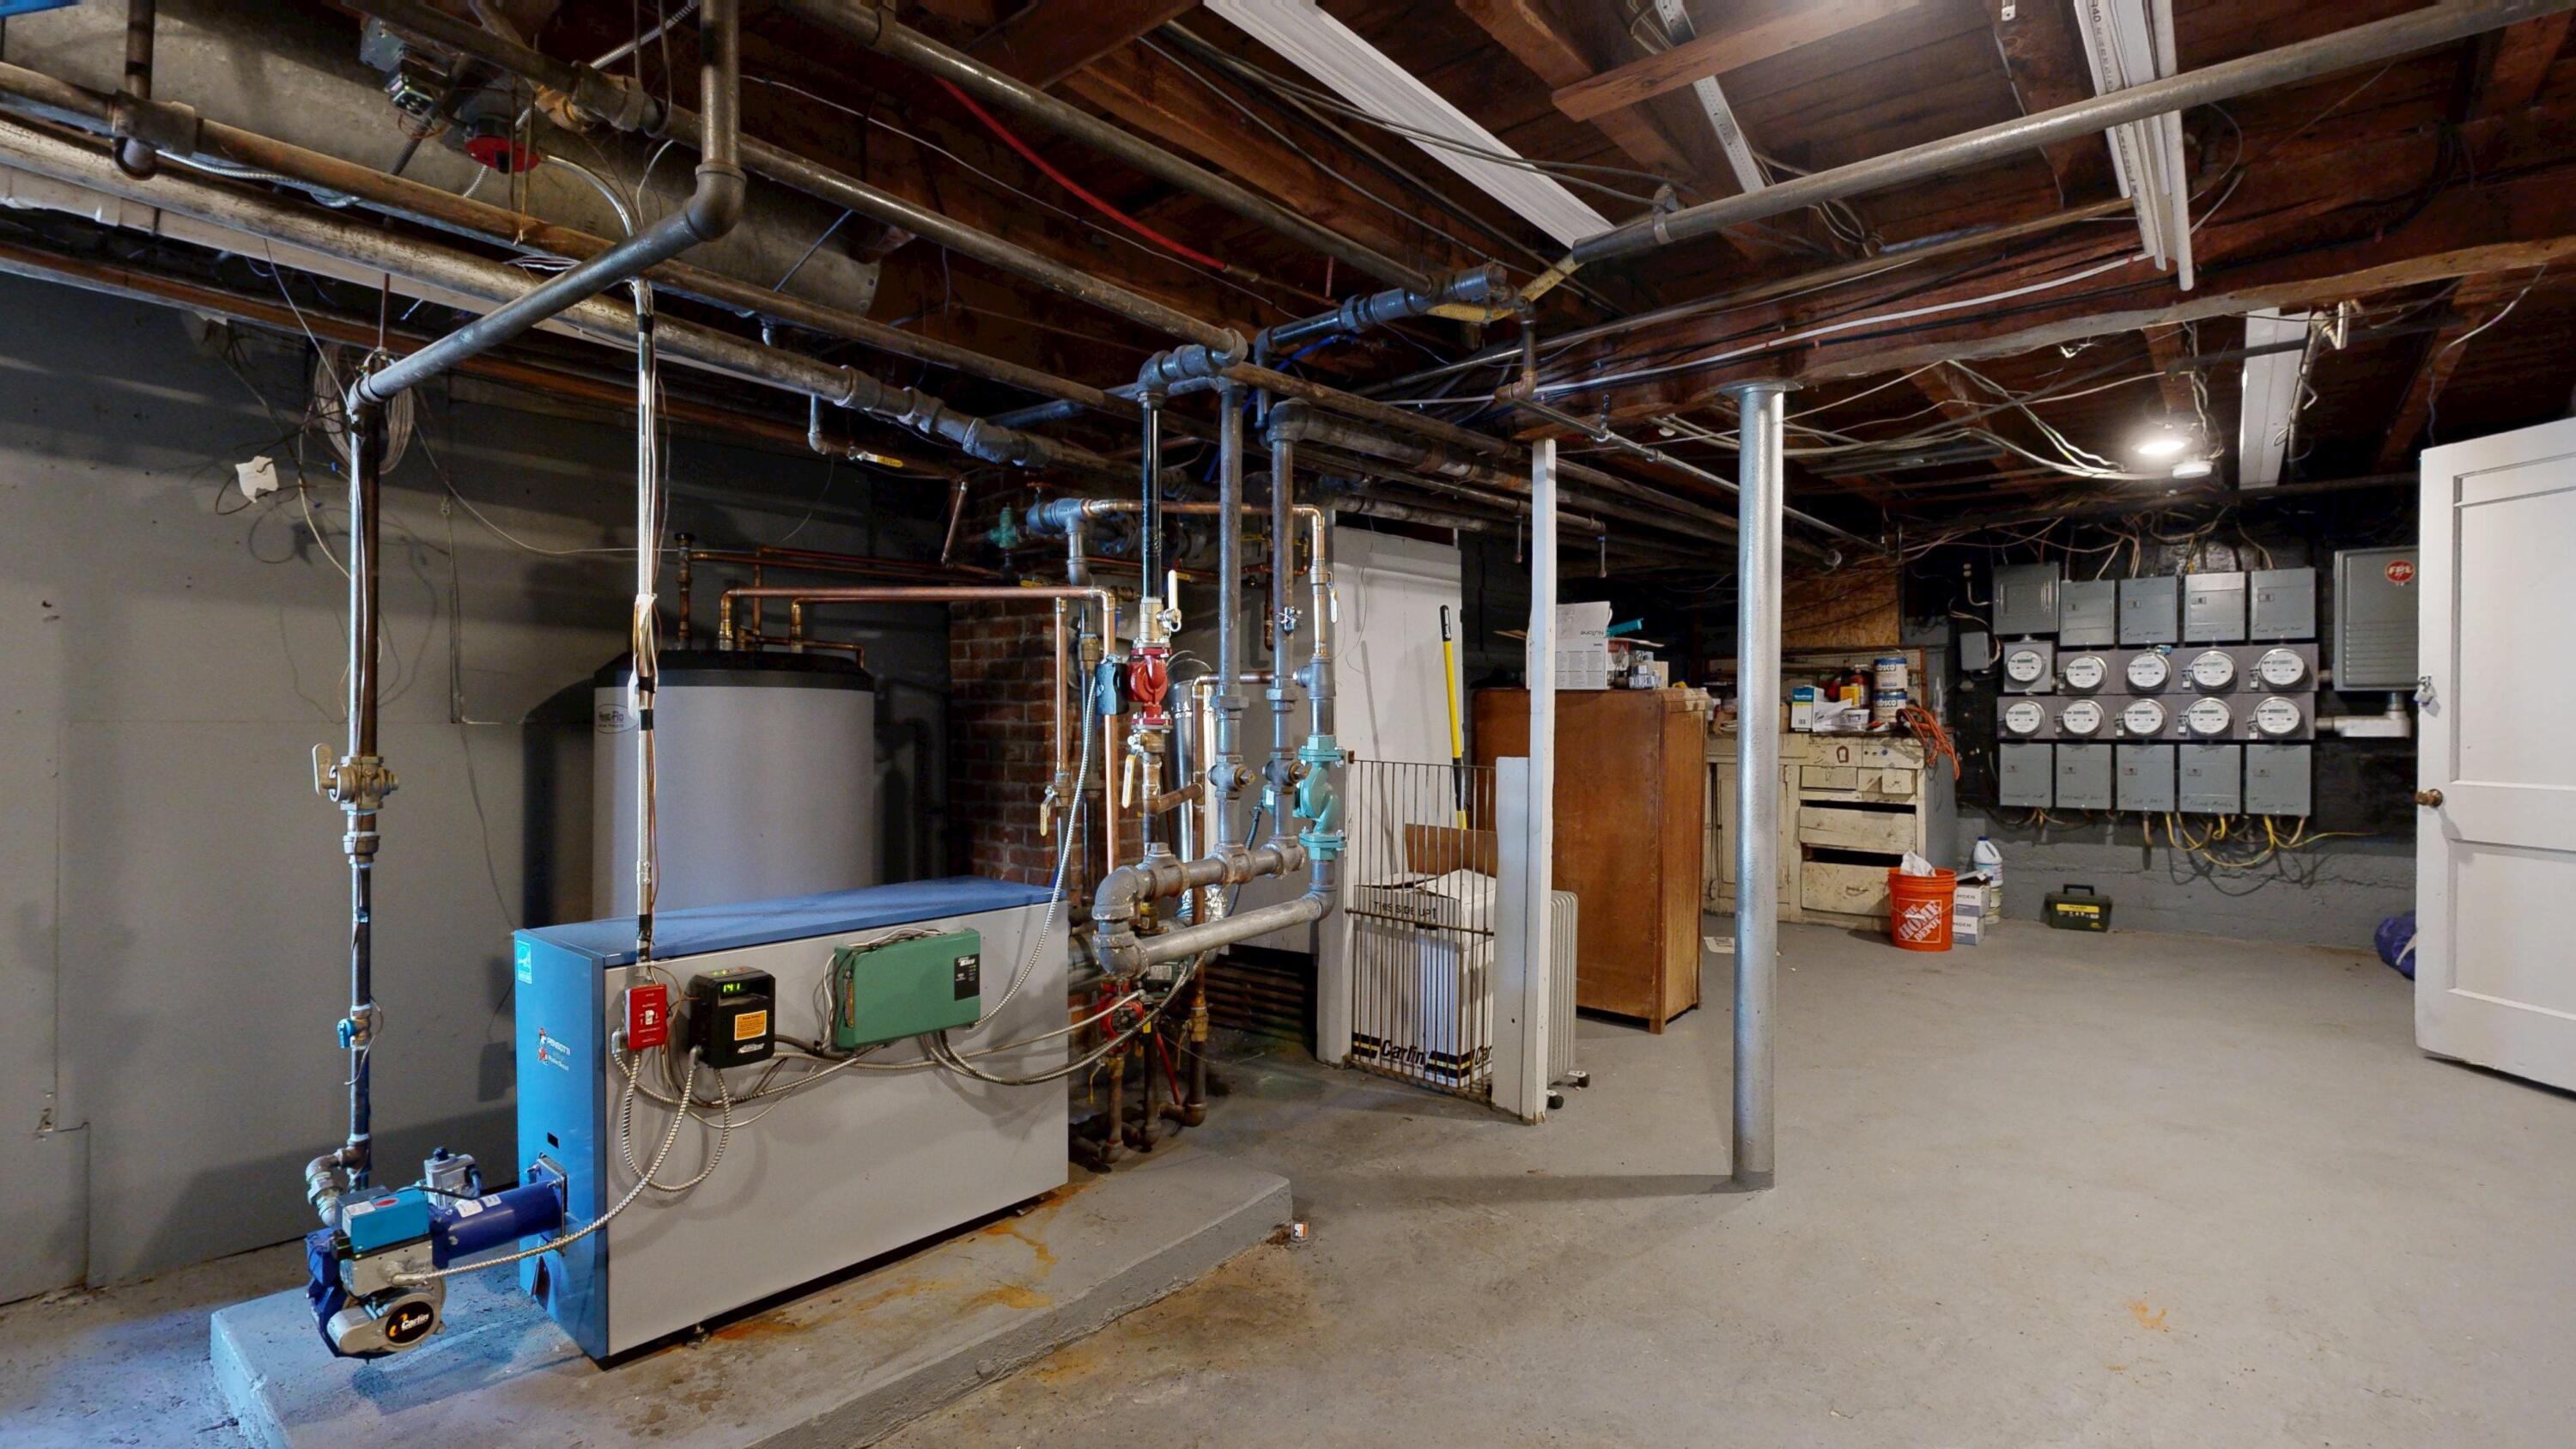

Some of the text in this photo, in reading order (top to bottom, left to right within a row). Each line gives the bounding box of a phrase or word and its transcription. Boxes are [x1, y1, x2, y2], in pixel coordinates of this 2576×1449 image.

[1395, 904, 1414, 916] SDE
[1899, 900, 1941, 941] HOME
[1913, 916, 1941, 941] DEPOT
[1382, 1039, 1425, 1065] Carlin
